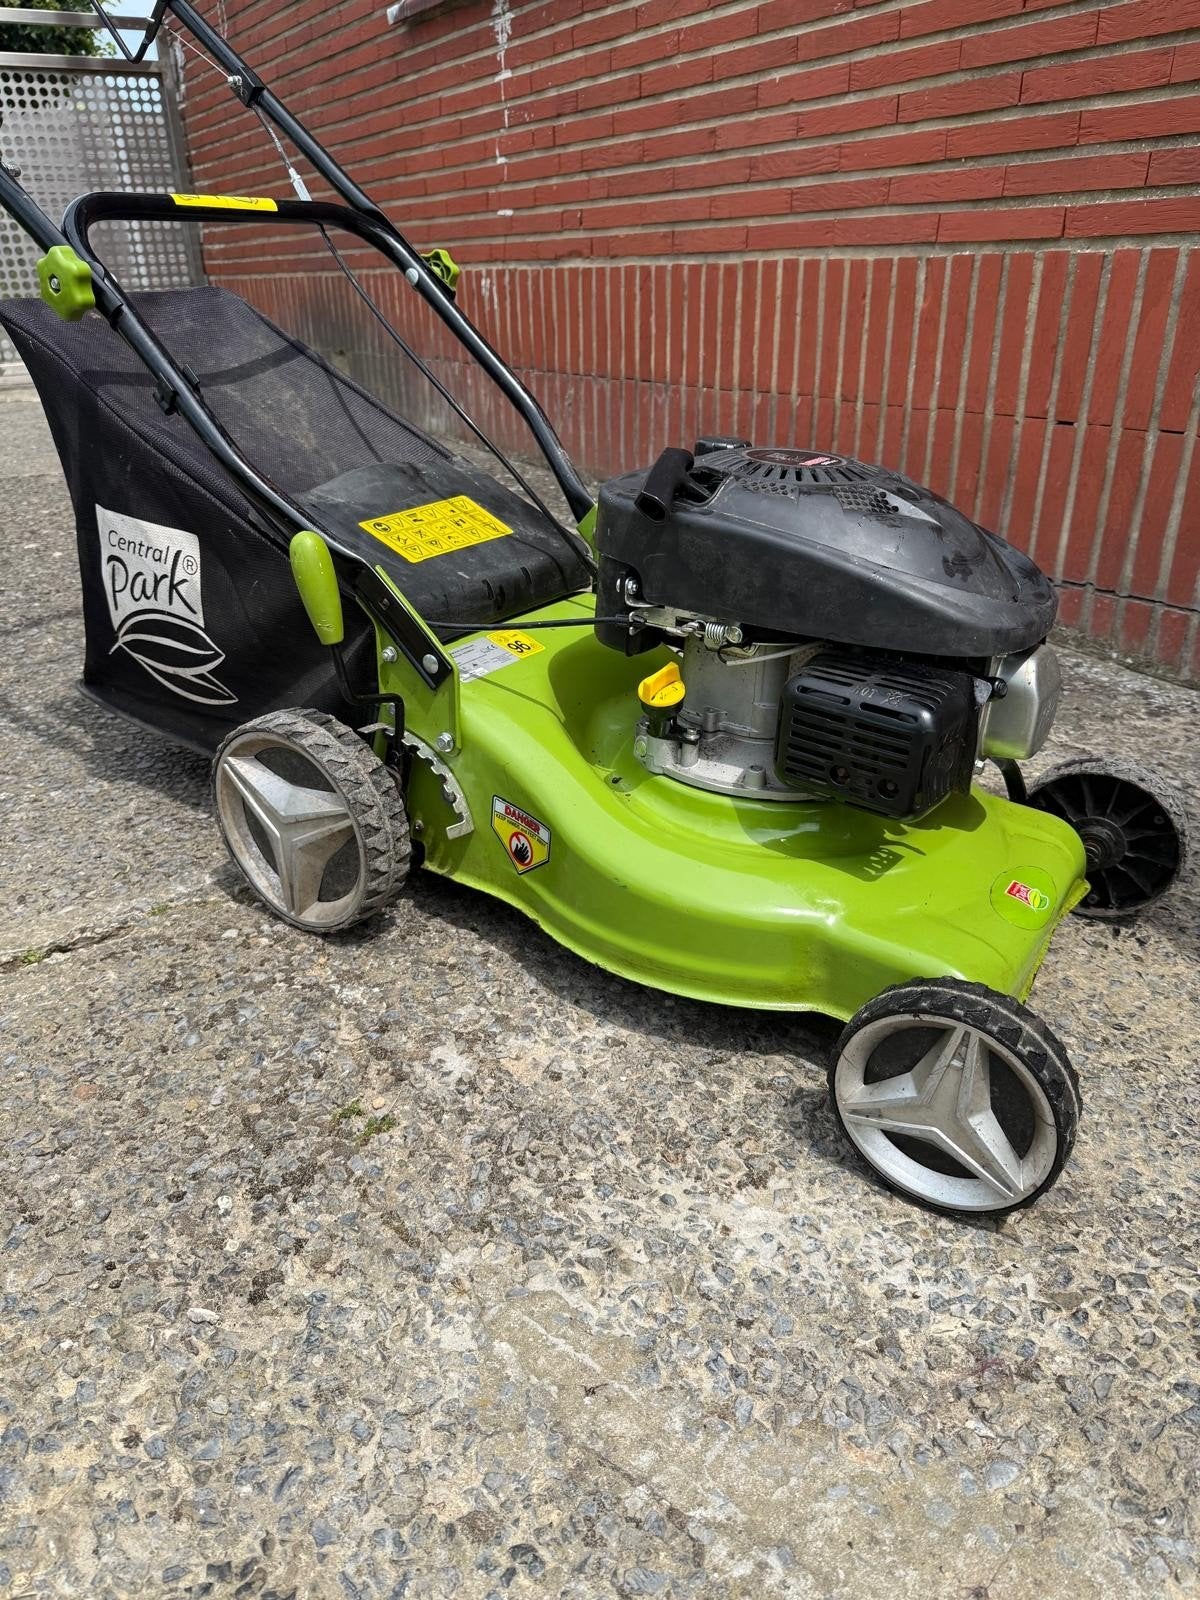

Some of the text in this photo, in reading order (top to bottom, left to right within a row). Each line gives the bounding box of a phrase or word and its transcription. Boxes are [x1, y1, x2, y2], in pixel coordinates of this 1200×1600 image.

[108, 530, 169, 564] Central
[106, 549, 198, 615] Park
[507, 640, 531, 653] 96
[505, 804, 540, 834] DANGER
